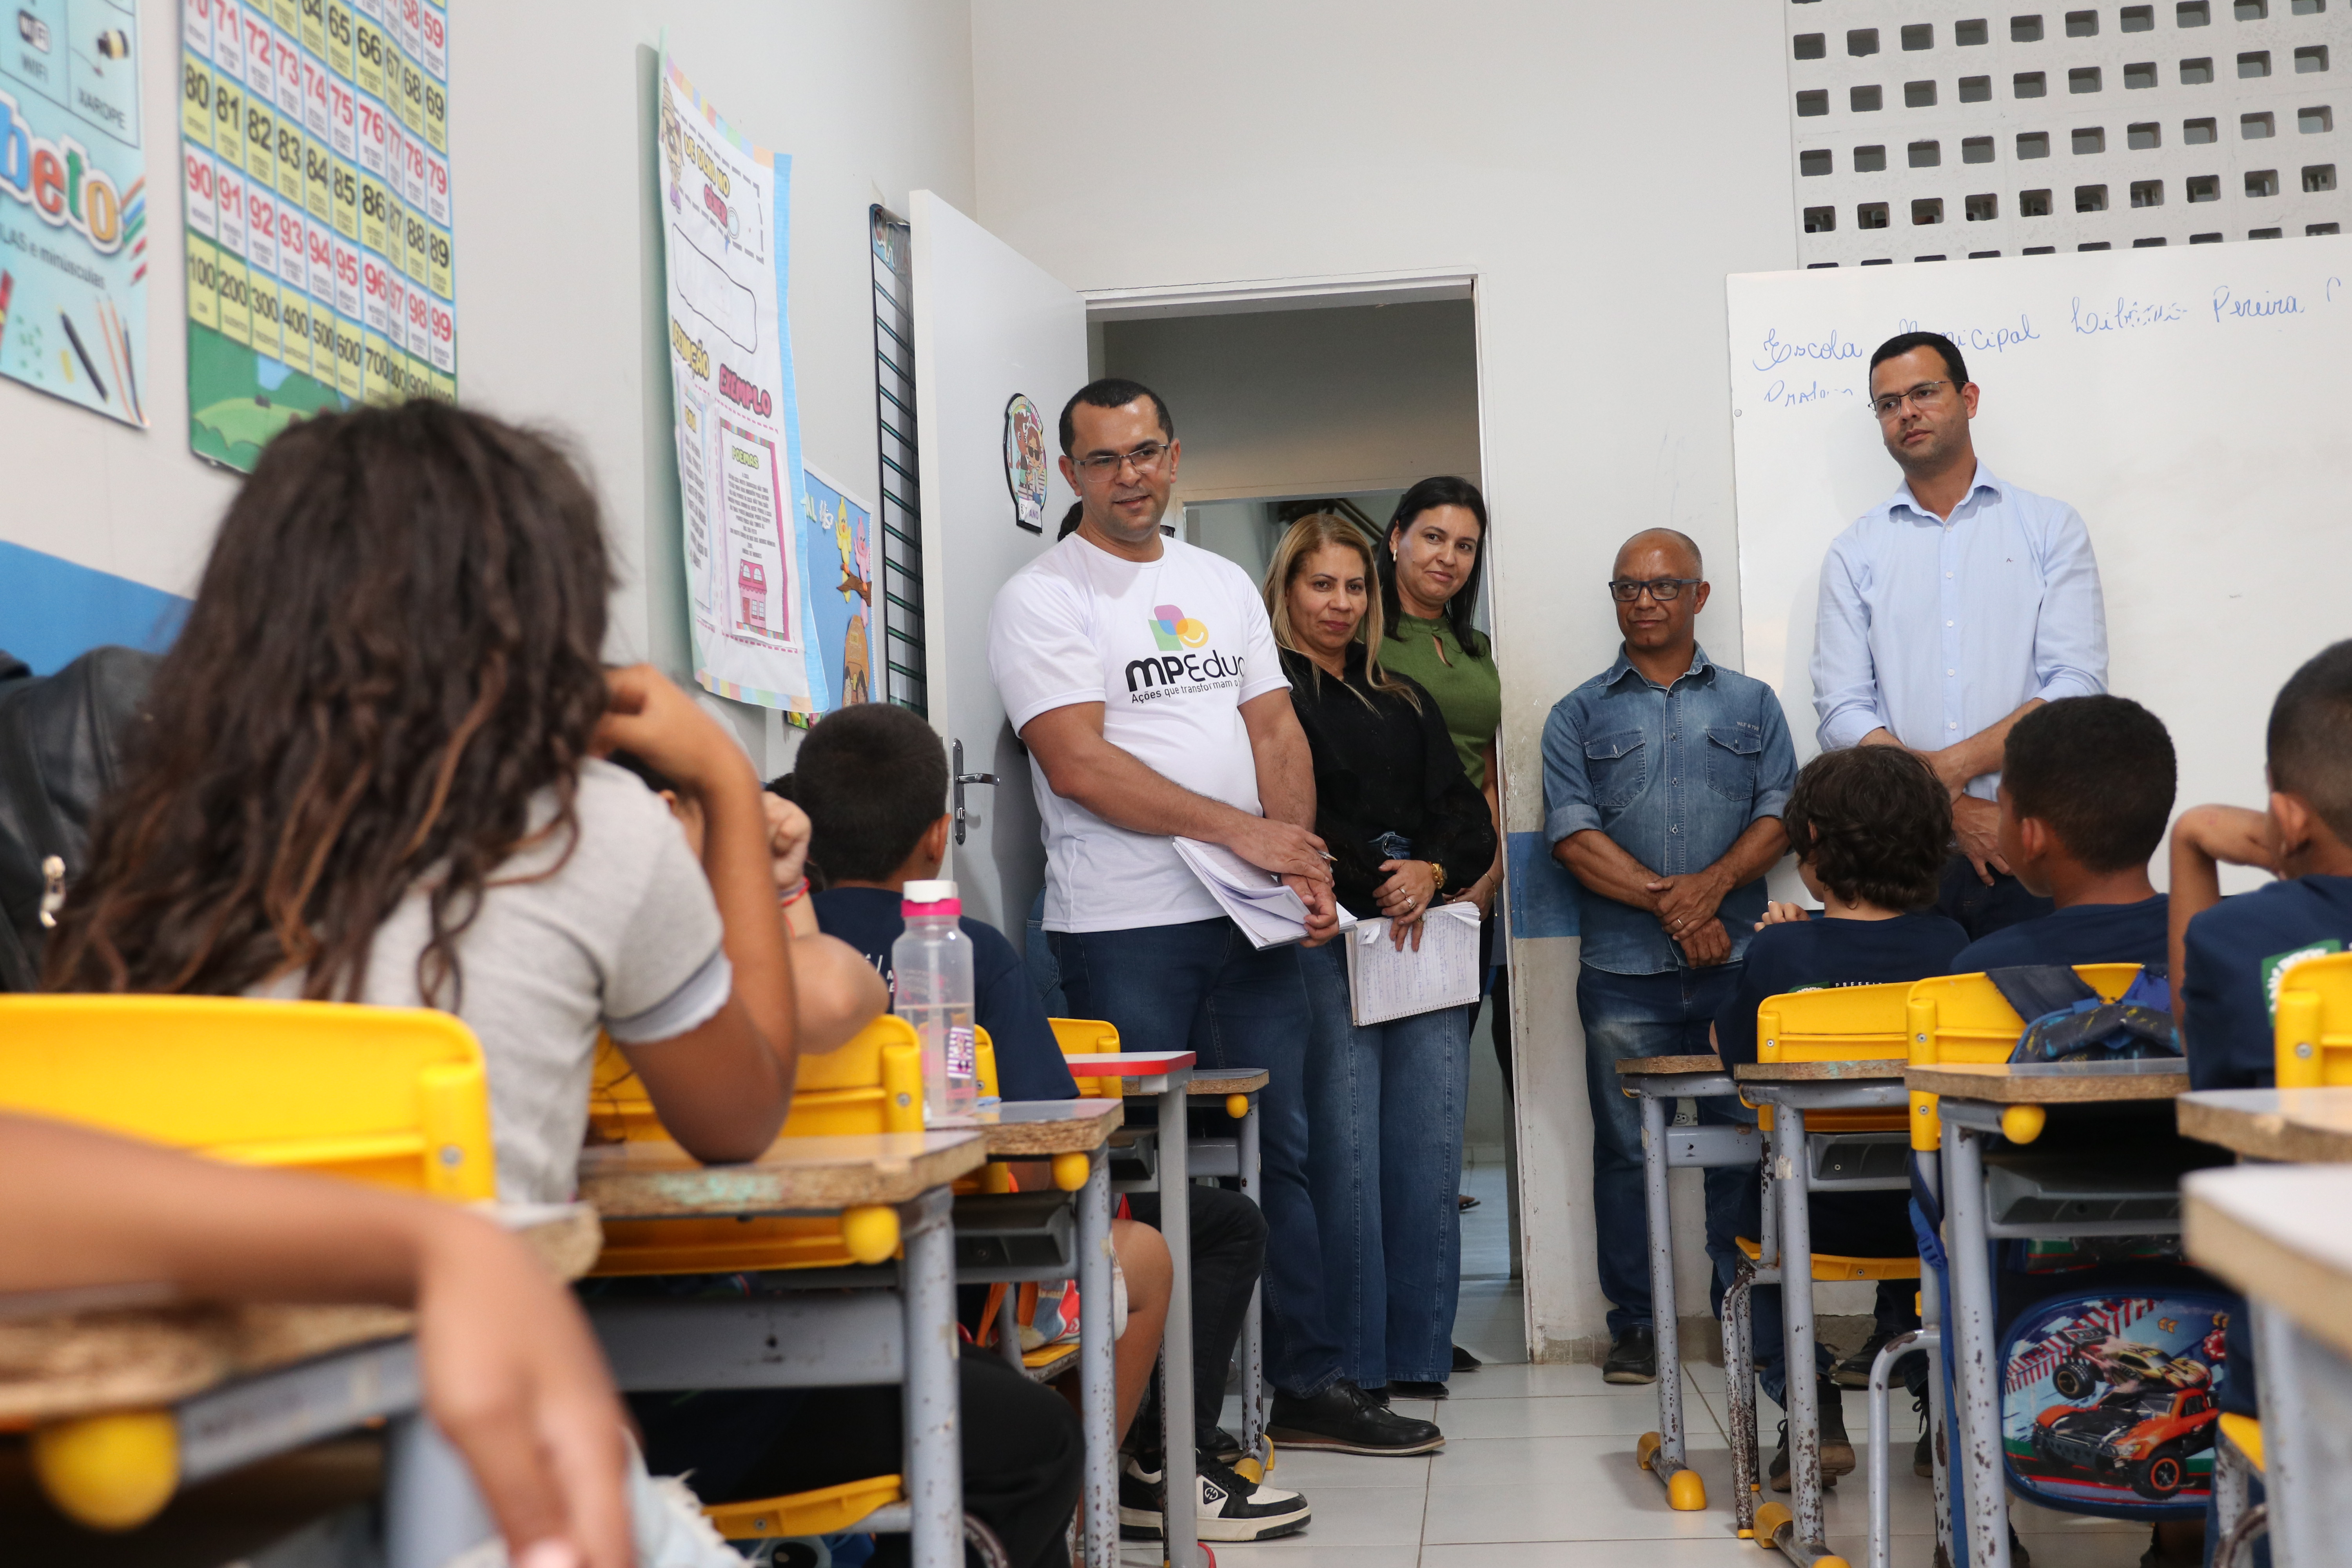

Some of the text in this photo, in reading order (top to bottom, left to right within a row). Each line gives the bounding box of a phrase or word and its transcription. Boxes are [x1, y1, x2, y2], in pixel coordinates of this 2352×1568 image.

[424, 9, 444, 49] 59
[328, 5, 352, 47] 65
[358, 26, 382, 67] 66
[386, 46, 401, 84] 67
[404, 66, 421, 105] 68
[426, 85, 445, 122] 69
[215, 0, 239, 43] 71
[244, 17, 272, 68] 72
[276, 41, 299, 87] 73
[304, 62, 327, 108] 74
[330, 83, 353, 126] 75
[359, 102, 384, 145] 76
[388, 122, 401, 162] 77
[405, 140, 424, 180] 78
[427, 157, 447, 195] 79
[185, 63, 209, 110] 80
[216, 85, 240, 132] 81
[248, 108, 272, 152] 82
[278, 128, 300, 171] 83
[307, 148, 328, 190] 84
[334, 167, 355, 207] 85
[362, 184, 385, 223] 86
[407, 217, 425, 254] 88
[430, 233, 449, 269] 89
[684, 131, 730, 199] DE OLHO NO
[186, 154, 213, 201] 90
[218, 175, 242, 220] 91
[249, 194, 274, 240] 92
[279, 212, 303, 255] 93
[309, 230, 331, 272] 94
[336, 247, 358, 287] 95
[364, 263, 387, 301] 96
[408, 293, 427, 330] 98
[432, 307, 452, 343] 99
[189, 253, 215, 291] 100
[218, 269, 247, 308] 200
[252, 286, 279, 324] 300
[283, 304, 309, 339] 400
[313, 318, 334, 352] 500
[337, 334, 361, 367] 600
[366, 347, 388, 381] 700
[1753, 328, 1862, 371] Escola
[719, 363, 772, 419] EXEMPLO
[732, 445, 759, 470] POEMAS
[1029, 509, 1039, 520] ANO
[1132, 689, 1162, 704] Ações
[1165, 686, 1180, 698] que
[1181, 679, 1233, 694] transformam
